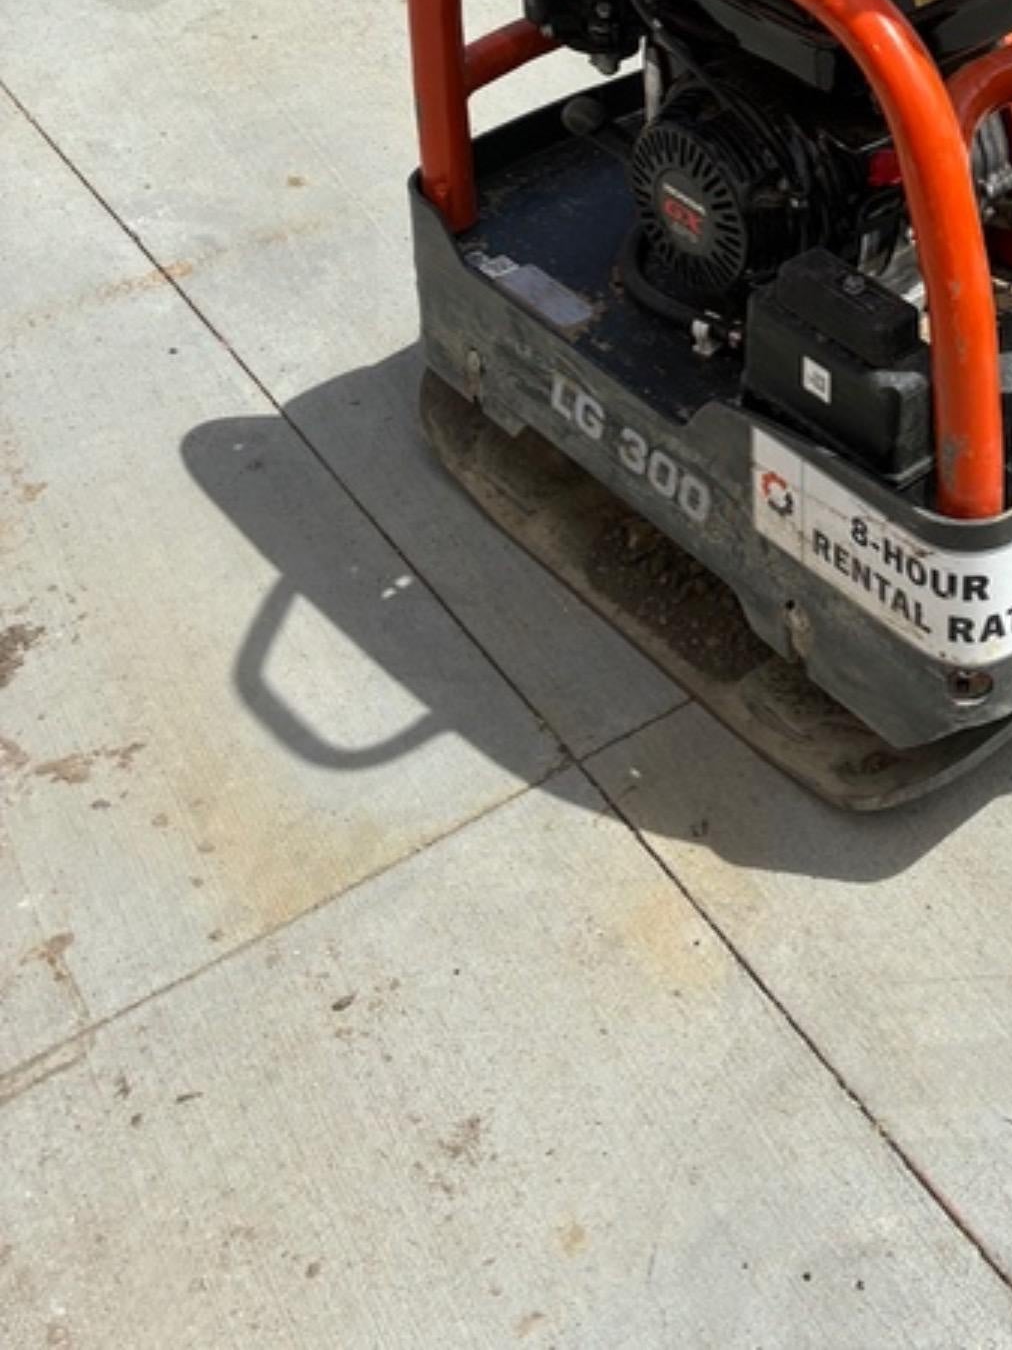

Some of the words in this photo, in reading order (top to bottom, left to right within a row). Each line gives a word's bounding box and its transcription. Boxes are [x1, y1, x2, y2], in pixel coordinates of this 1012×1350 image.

[551, 373, 606, 441] LG
[617, 426, 712, 523] 300
[811, 530, 932, 635] RENTAL
[850, 515, 990, 603] 8-HOUR
